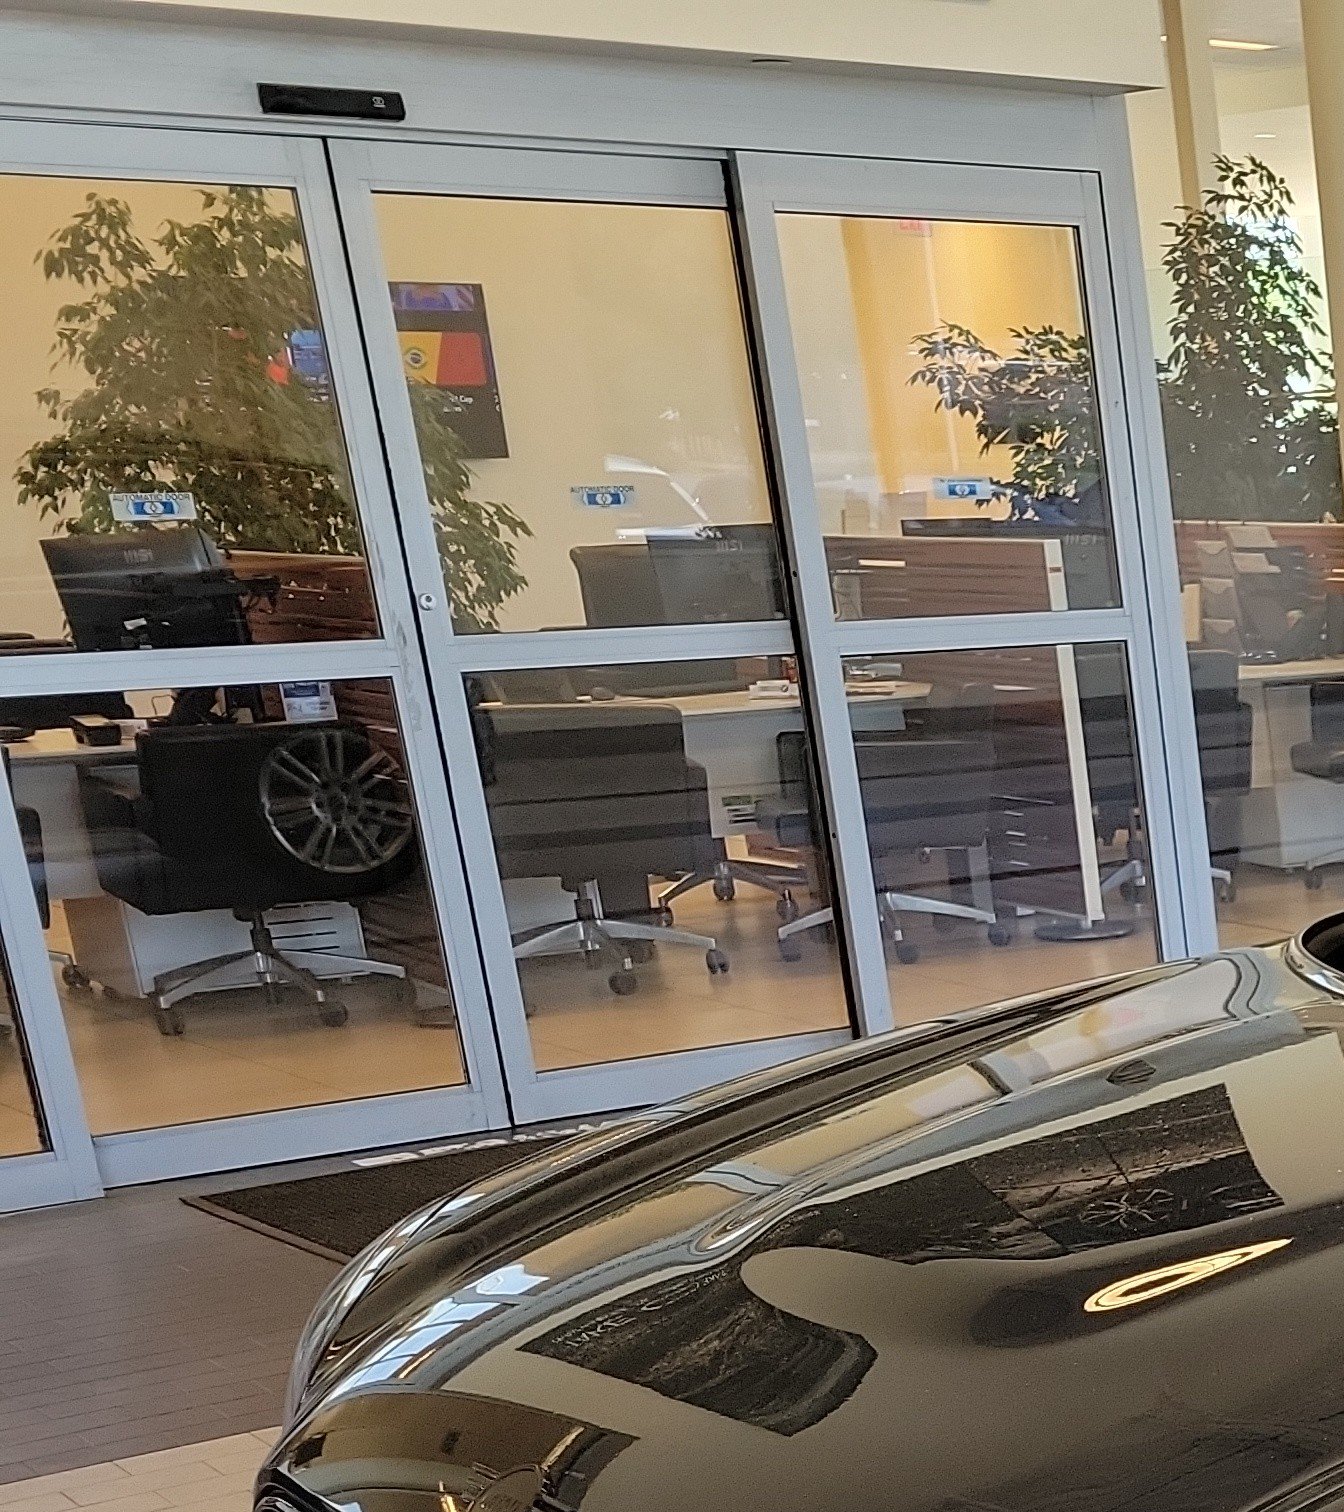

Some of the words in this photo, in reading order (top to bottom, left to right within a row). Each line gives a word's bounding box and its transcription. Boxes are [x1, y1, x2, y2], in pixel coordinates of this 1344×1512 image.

[613, 485, 635, 493] DOOR
[112, 494, 163, 502] AUTOMATIC
[165, 493, 190, 501] DOOR
